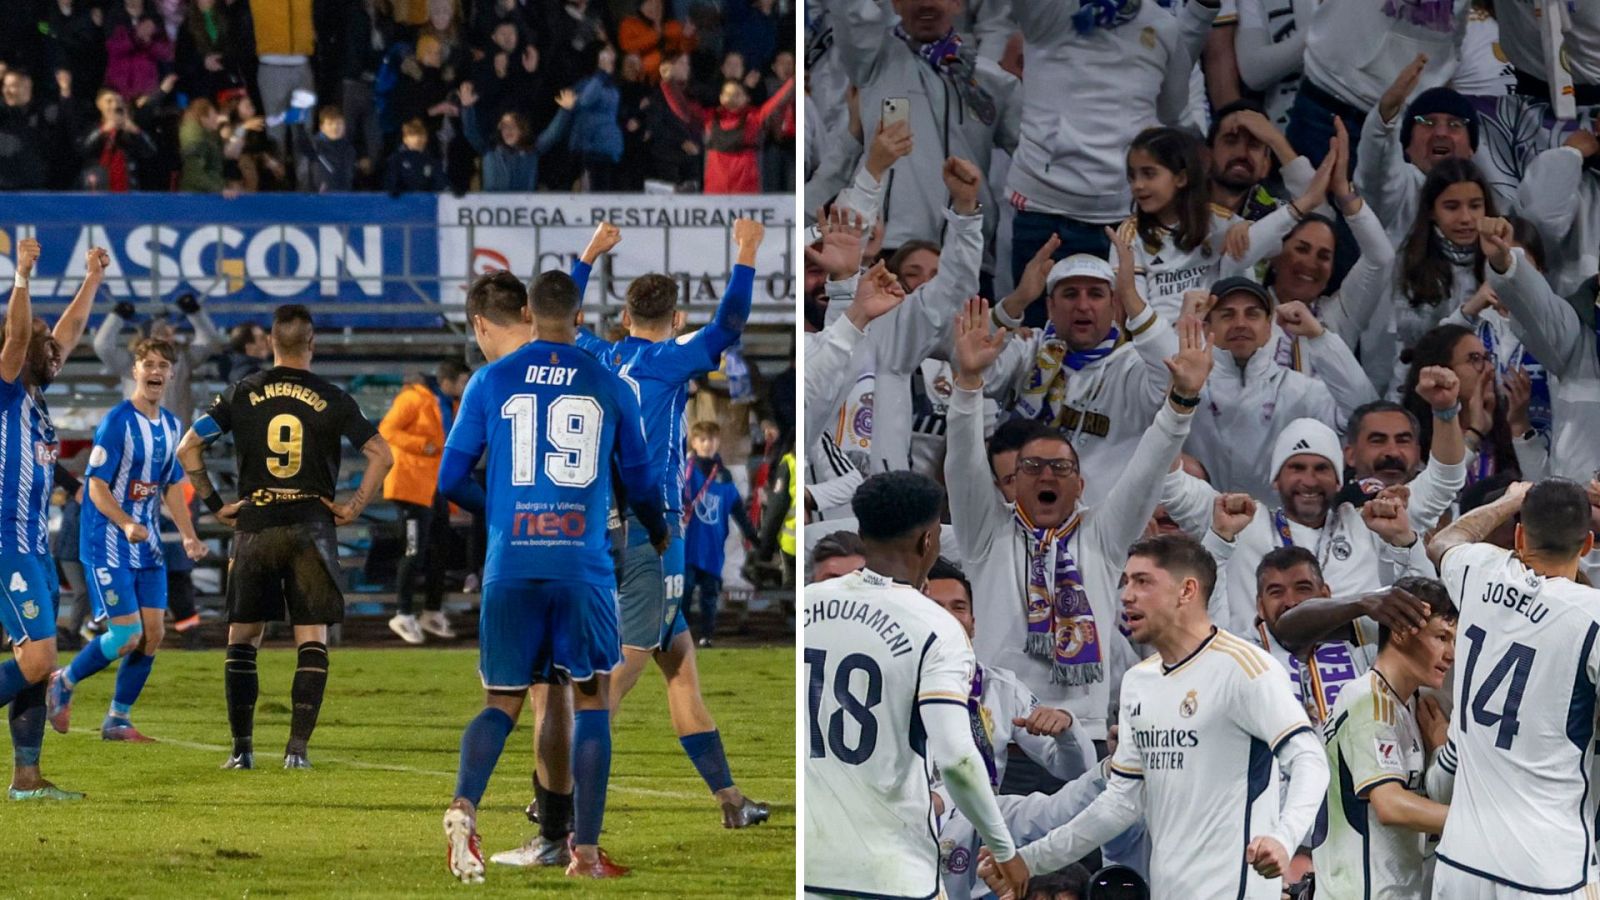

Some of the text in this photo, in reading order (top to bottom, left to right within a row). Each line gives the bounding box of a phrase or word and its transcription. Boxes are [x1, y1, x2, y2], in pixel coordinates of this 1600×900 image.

[458, 208, 565, 226] BODEGA
[591, 208, 774, 226] RESTAURANTE
[525, 365, 578, 386] DEIBY
[266, 413, 303, 478] 9
[501, 393, 604, 489] 19
[512, 512, 586, 537] neo
[9, 571, 28, 592] 4
[96, 567, 112, 586] 5
[664, 574, 684, 599] 18
[1482, 582, 1549, 624] JOSELU
[1460, 623, 1537, 751] 14
[804, 647, 883, 766] 18
[1150, 751, 1184, 769] BETTER
